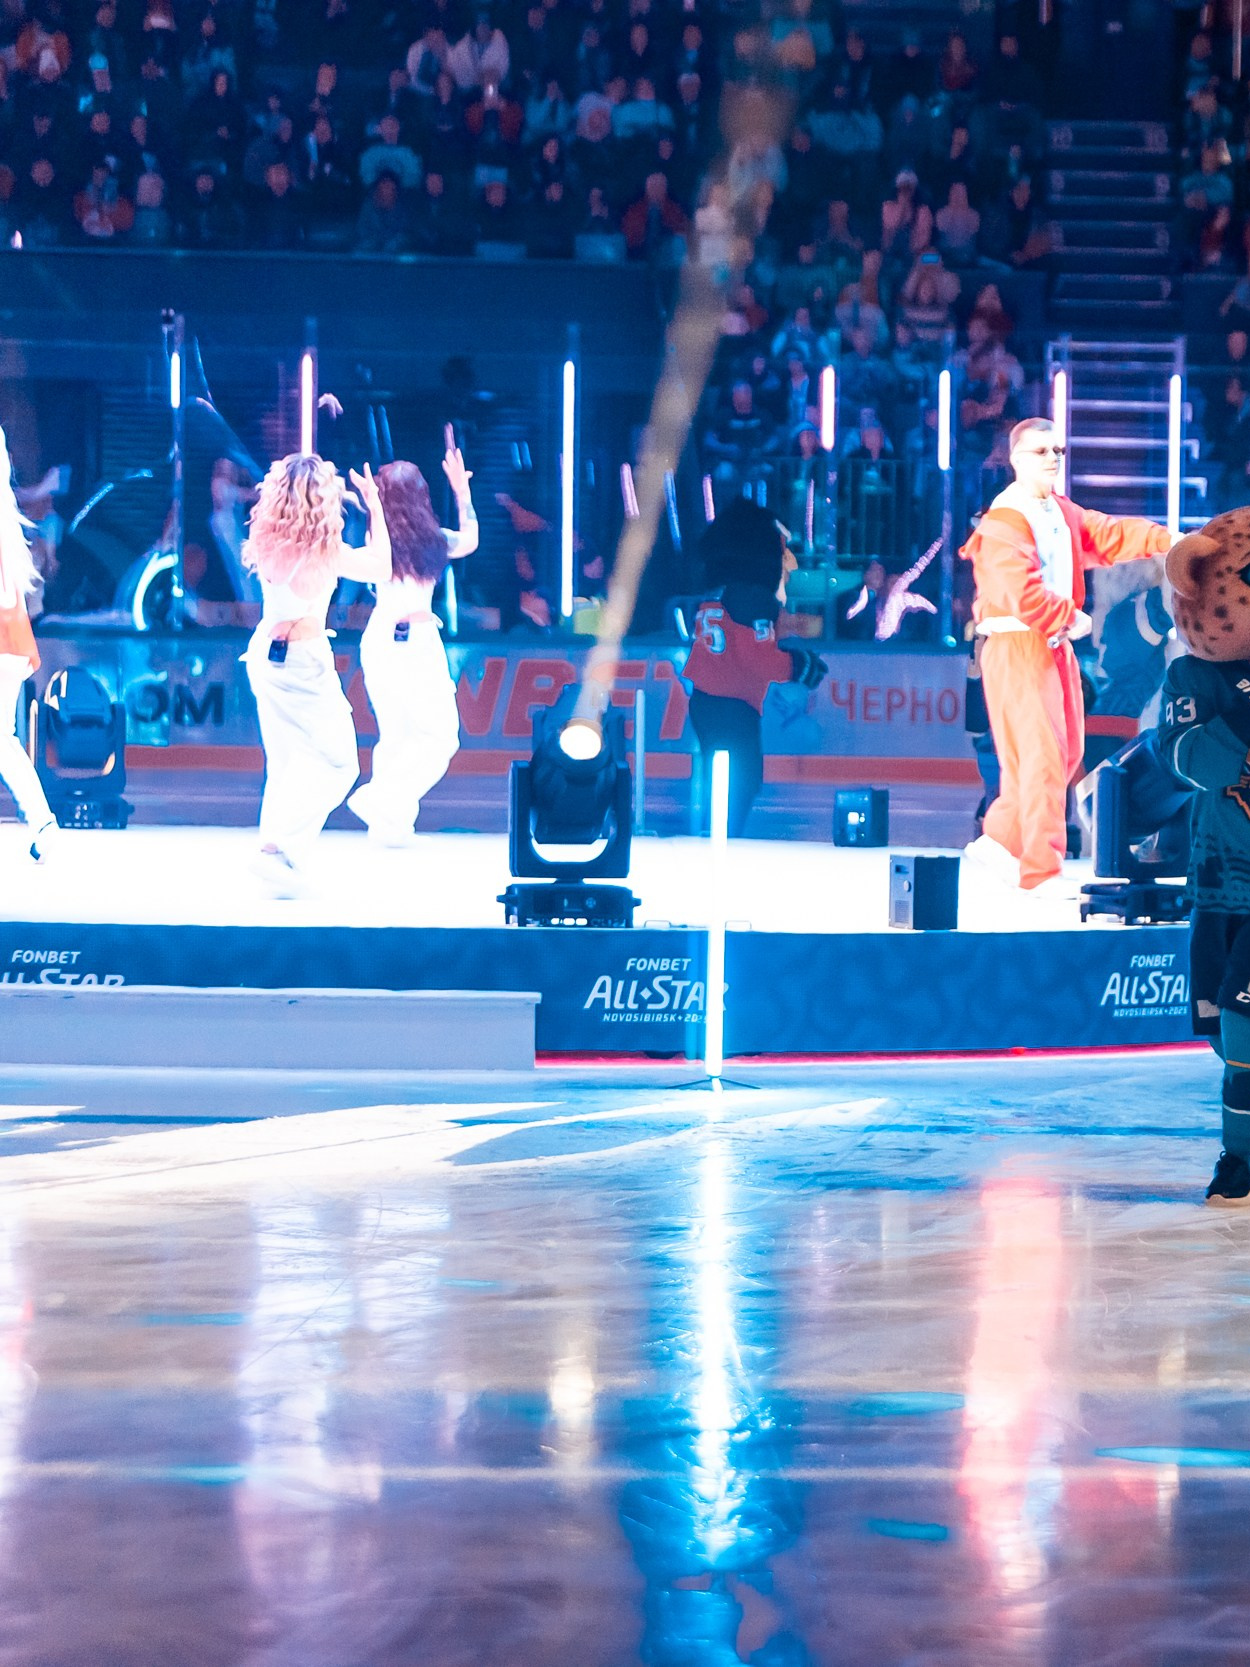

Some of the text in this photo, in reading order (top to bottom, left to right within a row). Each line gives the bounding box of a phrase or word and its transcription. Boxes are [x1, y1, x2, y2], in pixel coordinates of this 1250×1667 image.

[1166, 696, 1197, 725] 93
[11, 949, 82, 964] FONBET
[1130, 954, 1176, 968] FONBET
[626, 957, 692, 971] FONBET
[602, 1012, 677, 1022] NOVOSIBIRSK
